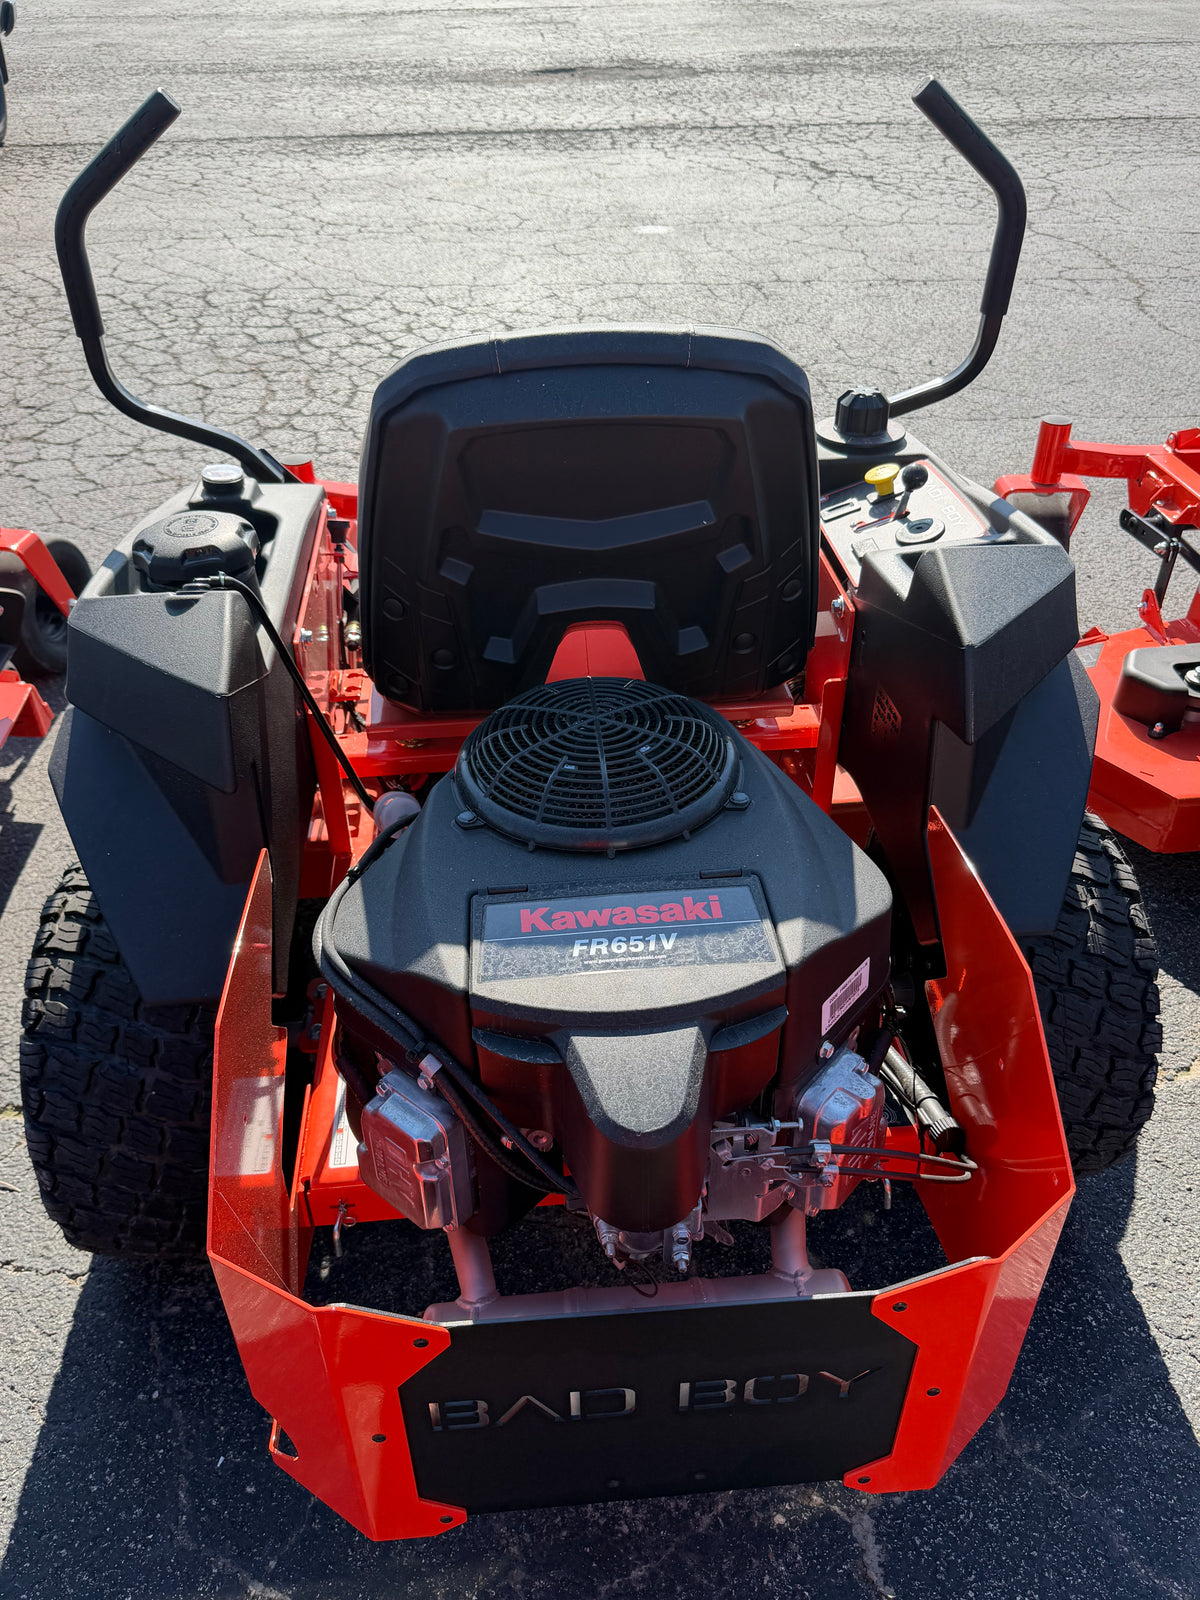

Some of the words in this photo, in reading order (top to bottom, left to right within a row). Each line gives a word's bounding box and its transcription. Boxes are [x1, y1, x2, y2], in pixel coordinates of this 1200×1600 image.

[519, 895, 723, 933] Kawasaki
[572, 932, 678, 957] FR651V
[428, 1388, 636, 1431] BAD
[677, 1368, 875, 1412] BOY
